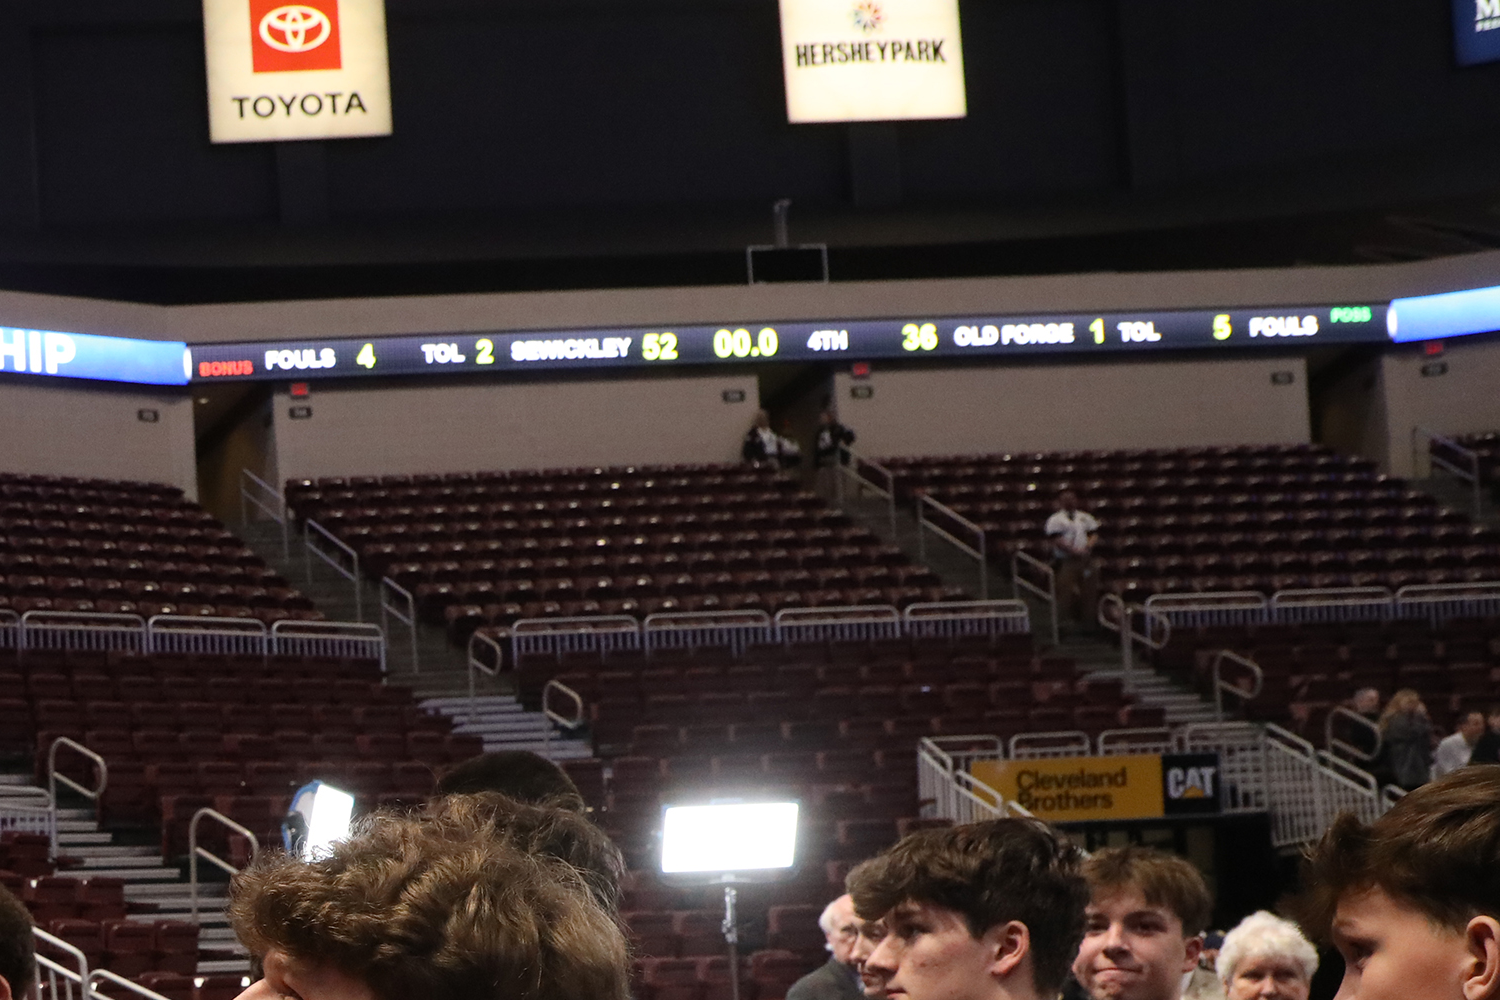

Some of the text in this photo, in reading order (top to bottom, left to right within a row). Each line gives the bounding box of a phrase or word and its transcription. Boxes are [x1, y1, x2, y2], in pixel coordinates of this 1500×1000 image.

[795, 38, 947, 68] HERSHEYPARK
[232, 90, 368, 119] TOYOTA
[199, 359, 254, 378] BONUS
[264, 347, 337, 371] FOULS
[355, 342, 377, 369] 4
[420, 342, 466, 364] TOL
[474, 338, 495, 365] 2
[641, 332, 679, 361] 52
[713, 326, 779, 358] 00.0
[806, 330, 849, 351] 4TH
[902, 322, 938, 351] 36
[953, 325, 1000, 347] OLD
[1001, 322, 1075, 345] FORGE
[1089, 317, 1106, 344] 1
[1117, 320, 1162, 343] TOL
[1212, 313, 1233, 340] 5
[1248, 314, 1319, 338] FOULS
[1016, 766, 1217, 799] Cleveland CAT
[1017, 790, 1114, 812] Brothers
